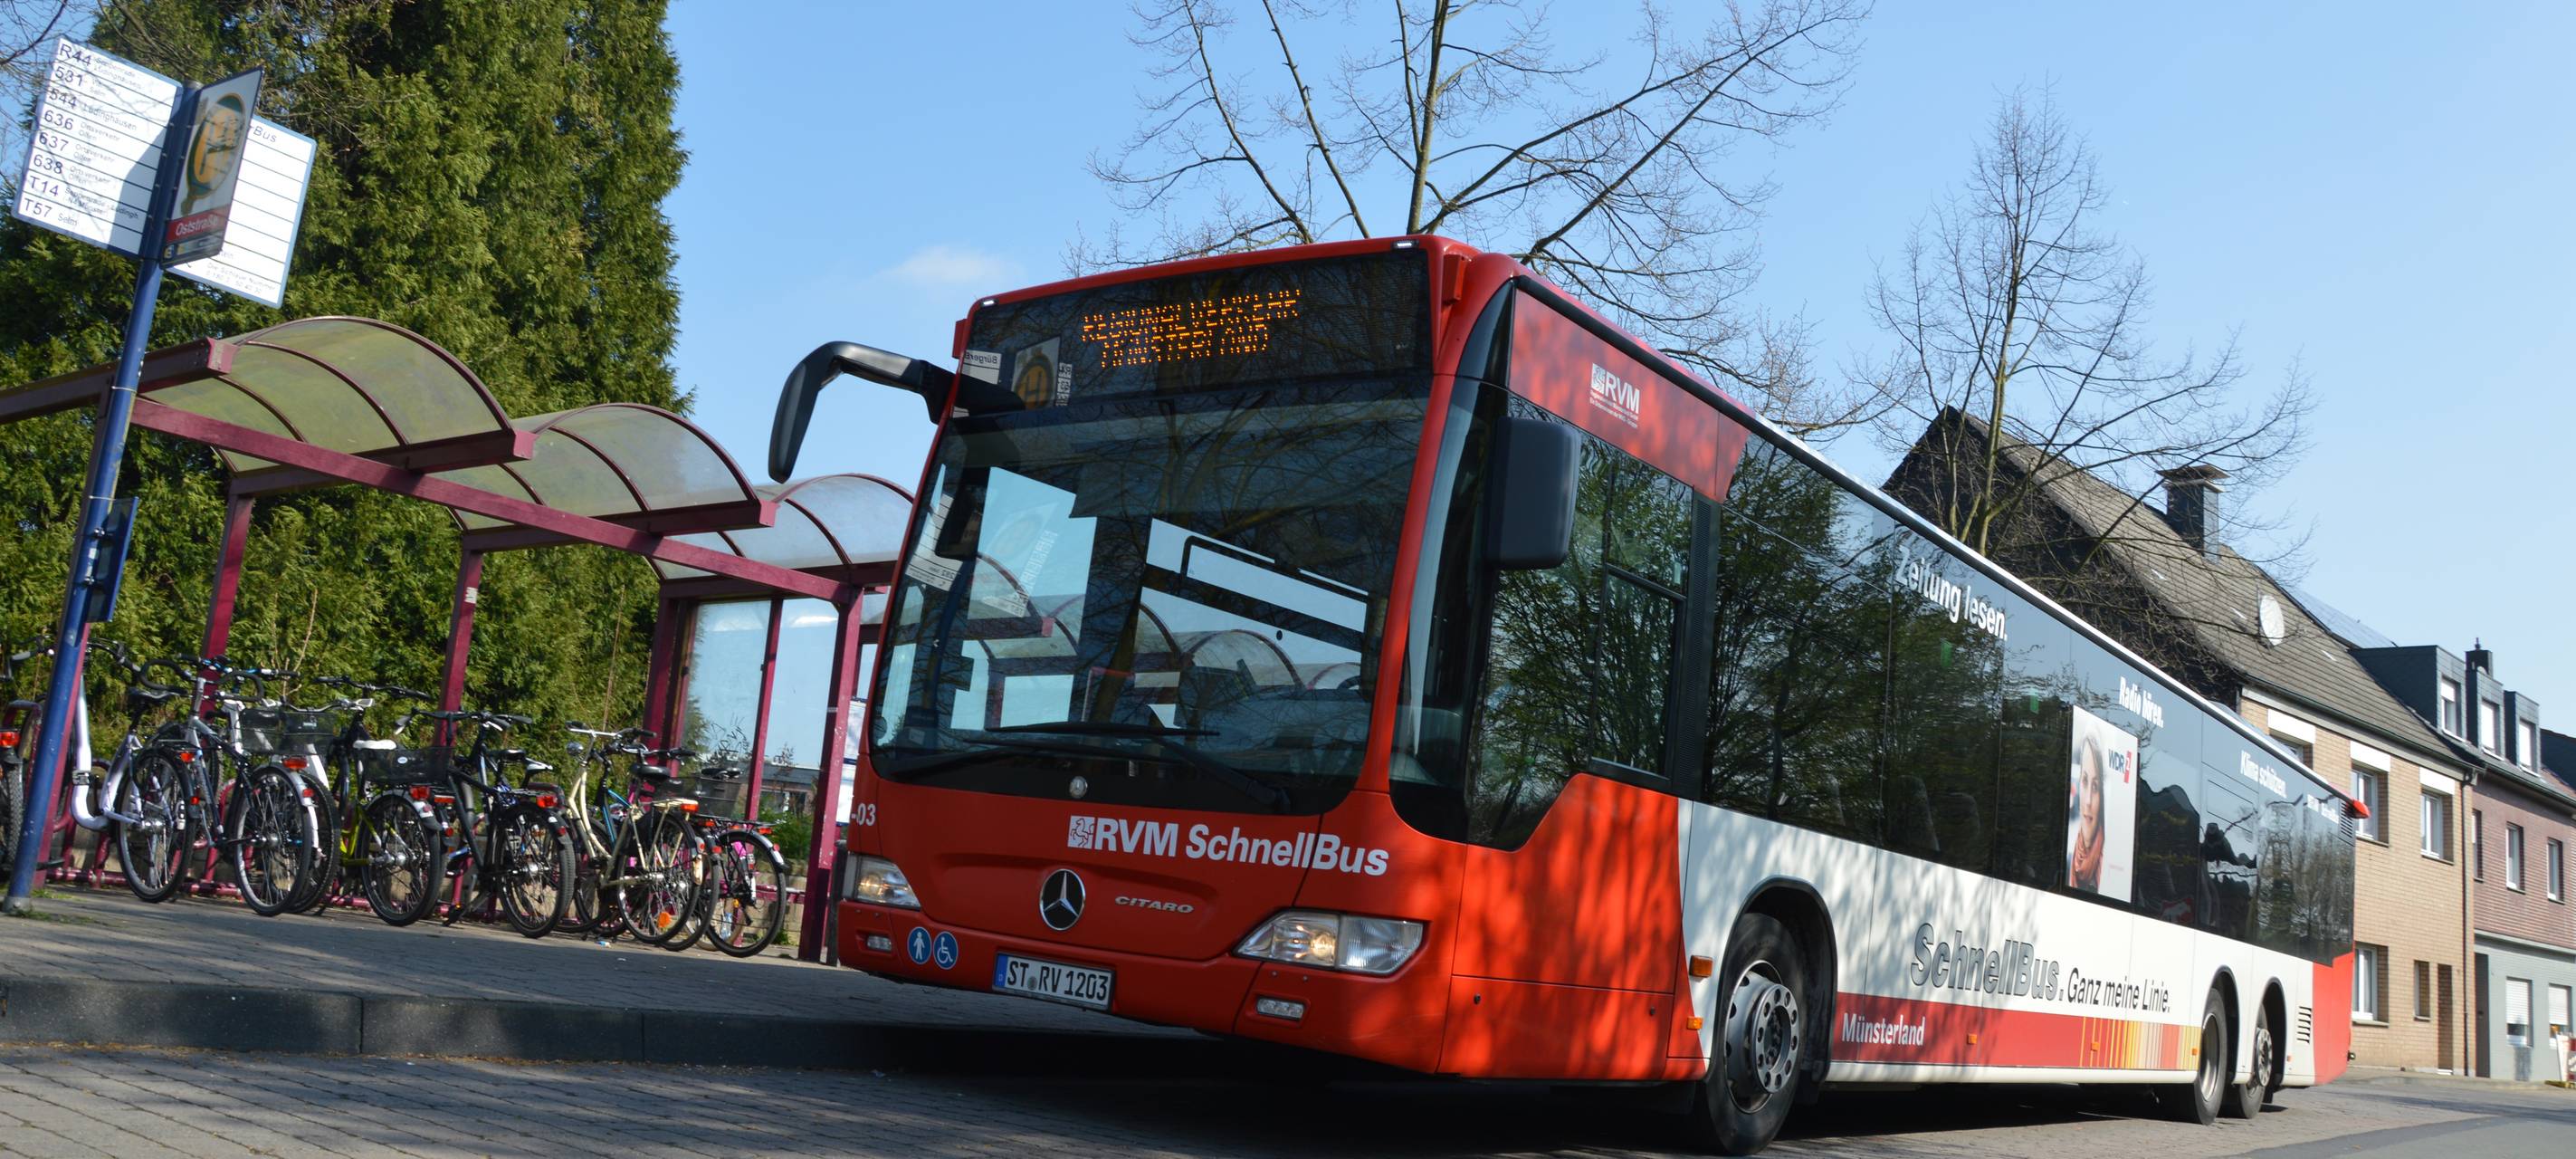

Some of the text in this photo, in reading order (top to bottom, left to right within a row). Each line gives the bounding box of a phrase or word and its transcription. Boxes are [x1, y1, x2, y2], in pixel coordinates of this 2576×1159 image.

[60, 43, 91, 66] R44
[54, 65, 84, 86] 531
[49, 88, 77, 109] 544
[44, 110, 74, 131] 636
[39, 130, 69, 152] 637
[33, 154, 63, 175] 638
[29, 175, 59, 197] T14
[24, 197, 52, 216] T57
[1605, 369, 1640, 415] RVM
[1895, 545, 2008, 641] Zeitung lesen.
[2119, 675, 2142, 716] Radio
[2108, 748, 2125, 774] WDR
[1093, 817, 1389, 876] RVM SchnellBus
[1114, 896, 1195, 914] CITARO
[1007, 960, 1029, 987] ST
[1038, 965, 1063, 993] RV
[1064, 970, 1109, 1001] 1203
[2067, 966, 2102, 1003] Ganz
[2104, 975, 2140, 1010] meine
[2142, 979, 2171, 1014] Linie.
[1841, 1011, 1927, 1047] Münsterland
